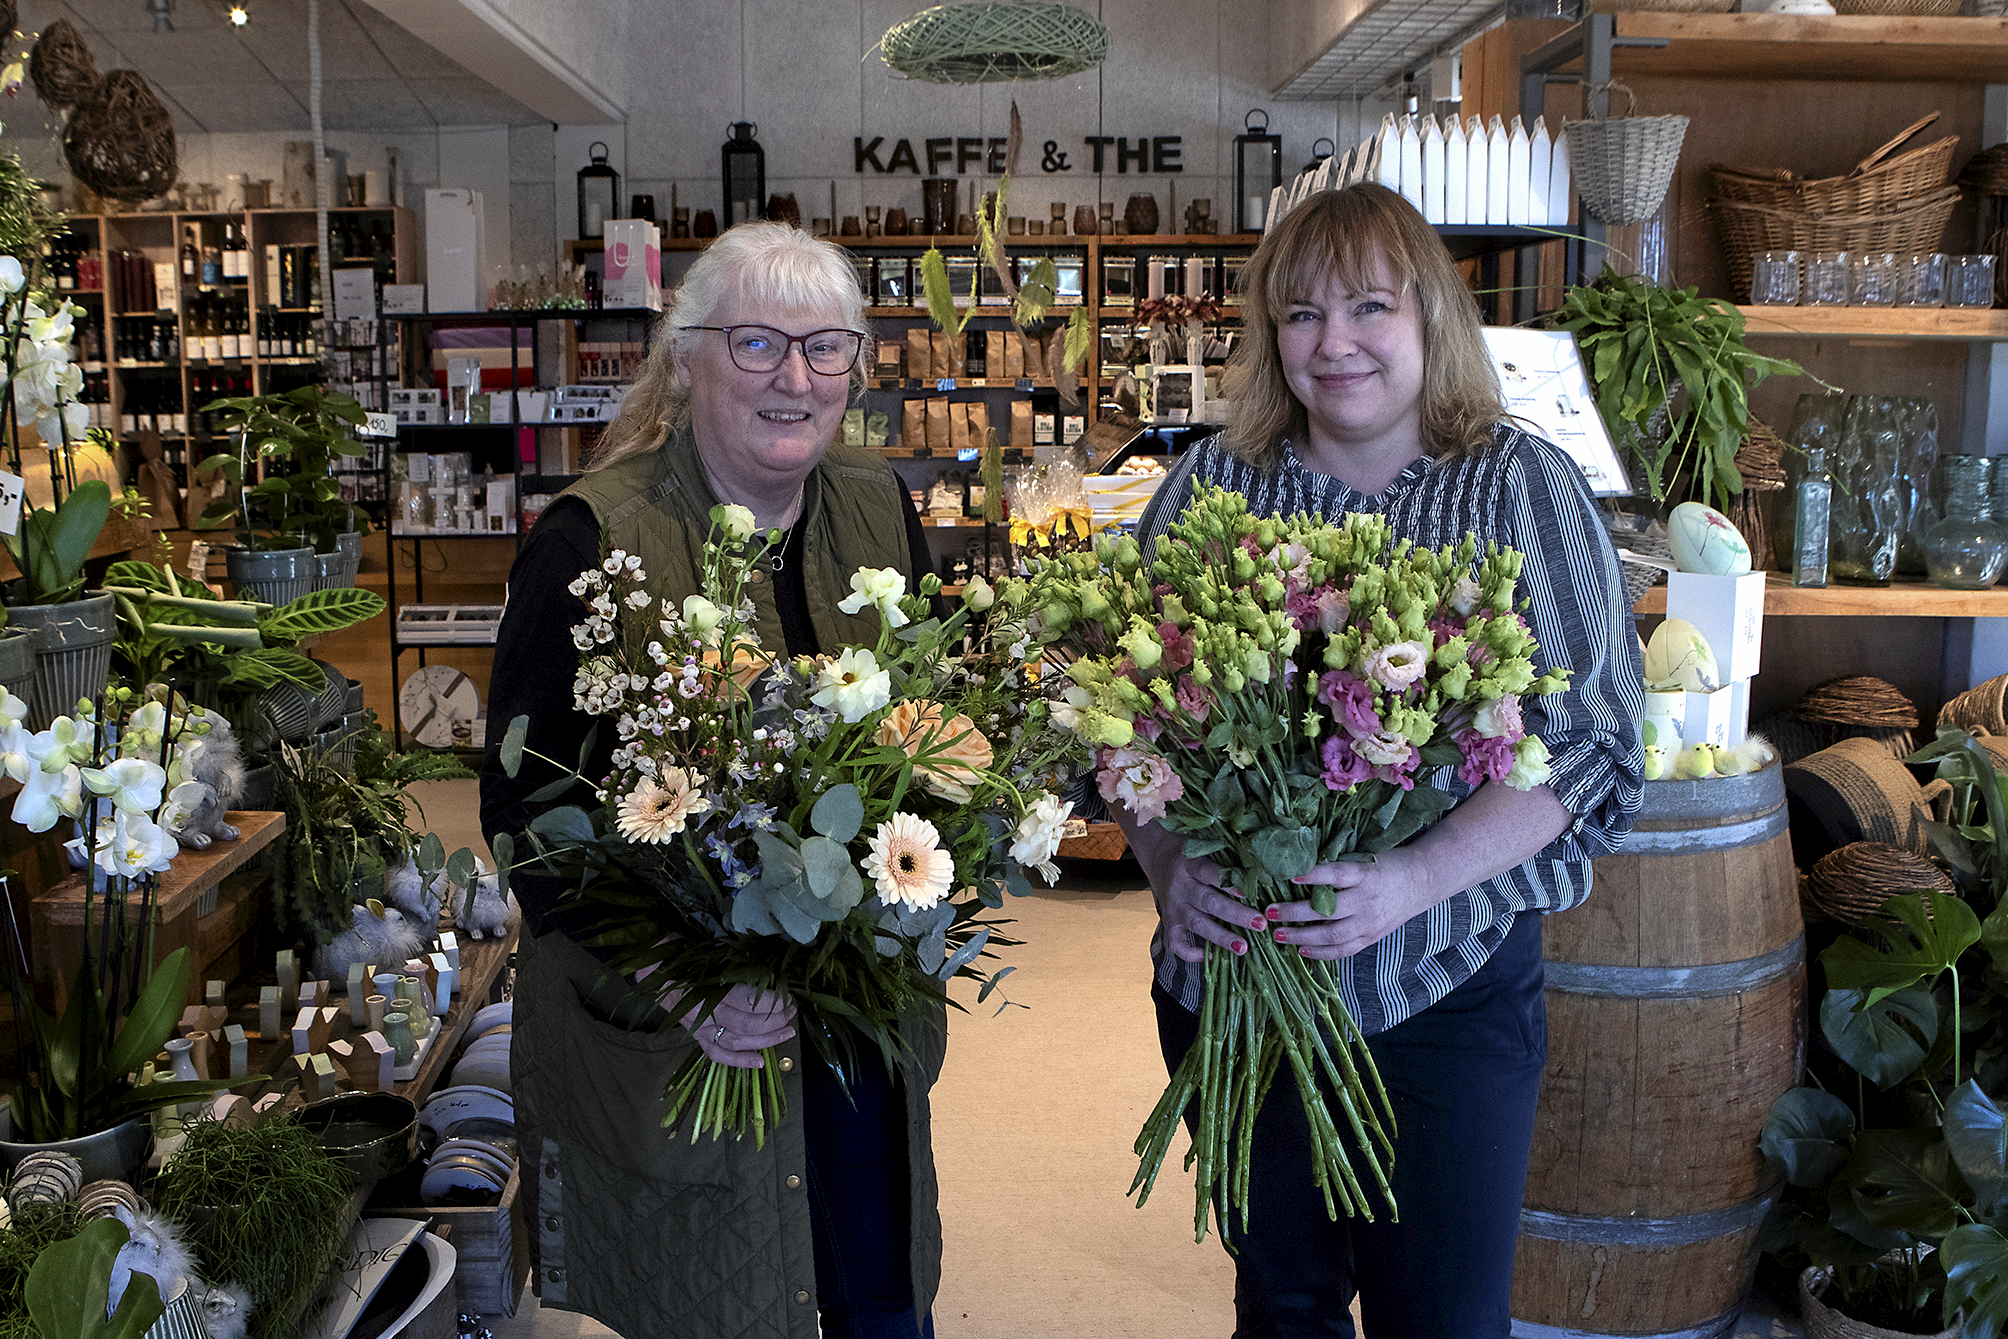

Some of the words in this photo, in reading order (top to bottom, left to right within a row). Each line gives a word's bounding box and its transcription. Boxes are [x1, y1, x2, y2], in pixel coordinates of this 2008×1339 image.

[854, 136, 1007, 175] KAFFE
[1041, 140, 1072, 173] &
[1084, 136, 1183, 173] THE
